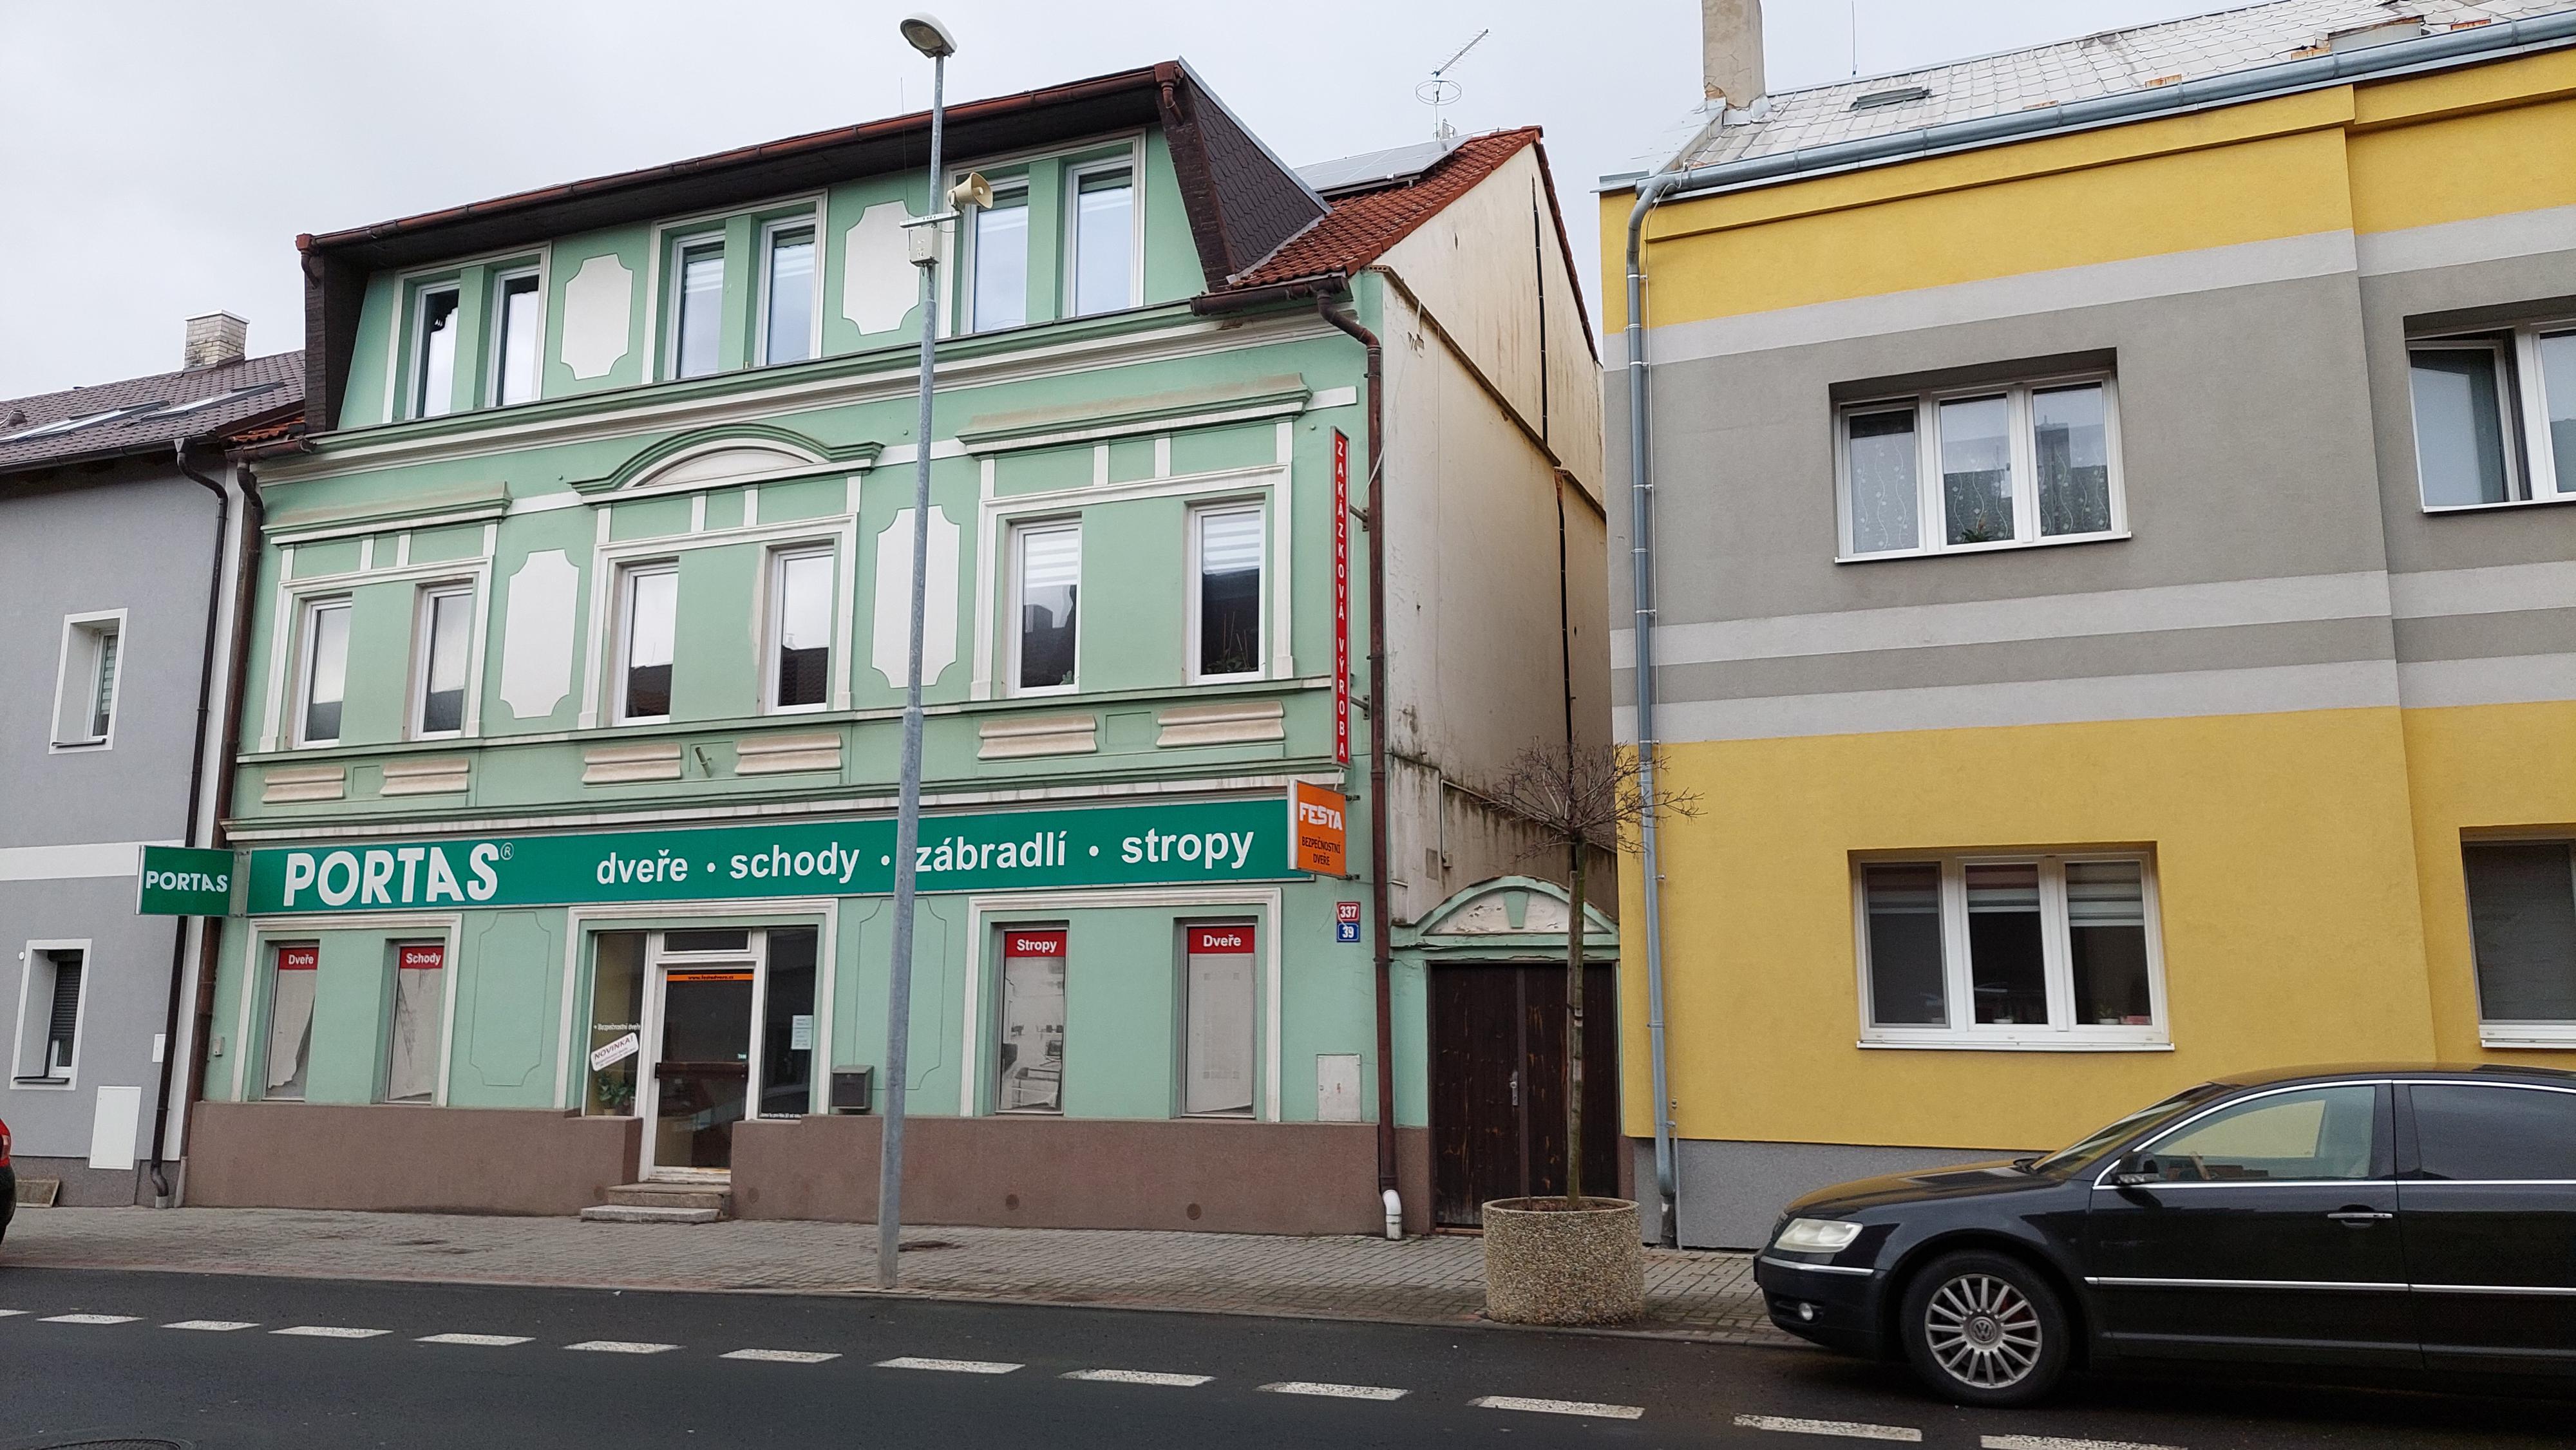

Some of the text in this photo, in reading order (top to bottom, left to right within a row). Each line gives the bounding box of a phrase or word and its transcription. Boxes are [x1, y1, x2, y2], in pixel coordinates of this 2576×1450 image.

[1299, 802, 1343, 831] FESTA
[1302, 836, 1341, 855] BEZPEČNOSTNÍ
[596, 827, 1255, 885] dveře schody zábradlí stropy
[1312, 852, 1331, 866] DVEŘE
[146, 871, 228, 893] PORTAS
[1340, 905, 1357, 919] 337
[1342, 926, 1354, 939] 39
[1016, 939, 1057, 954] Stropy
[1203, 934, 1242, 947] Dveře
[289, 954, 314, 965] Dveře
[406, 952, 442, 966] Schody
